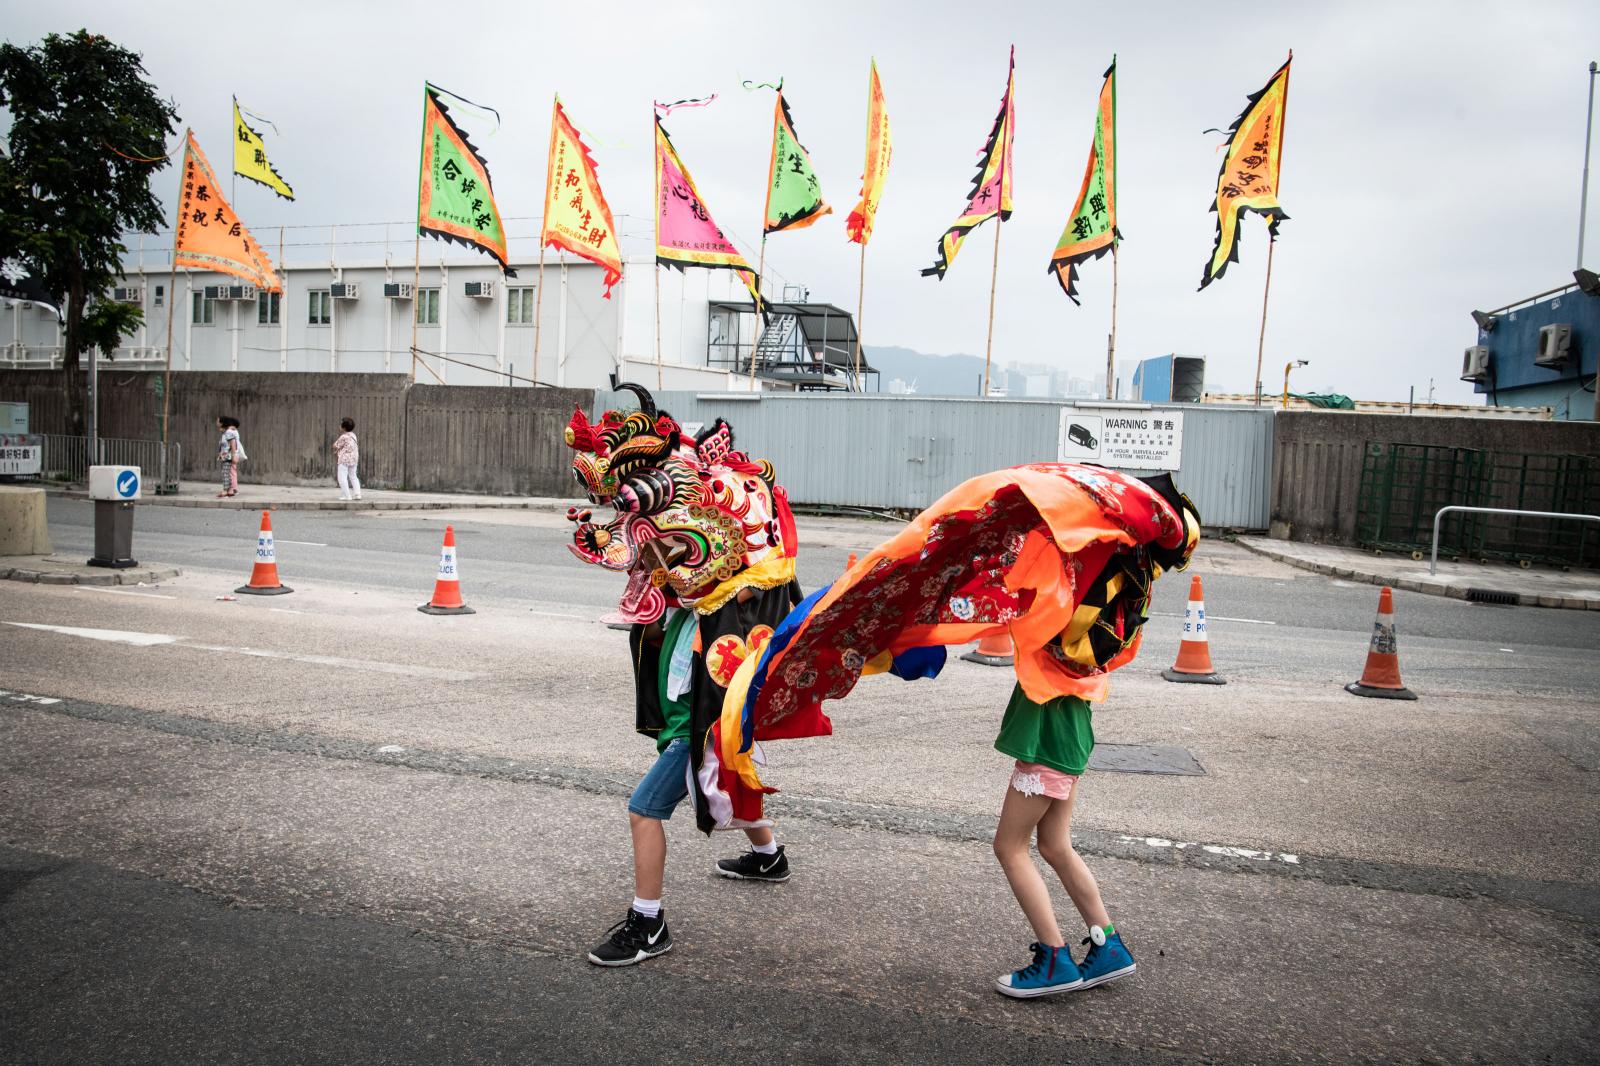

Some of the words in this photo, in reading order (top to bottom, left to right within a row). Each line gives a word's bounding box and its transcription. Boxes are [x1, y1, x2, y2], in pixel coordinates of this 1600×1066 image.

[564, 169, 607, 248] 和氣生財
[1105, 418, 1148, 430] WARNING
[1153, 420, 1174, 431] 警告
